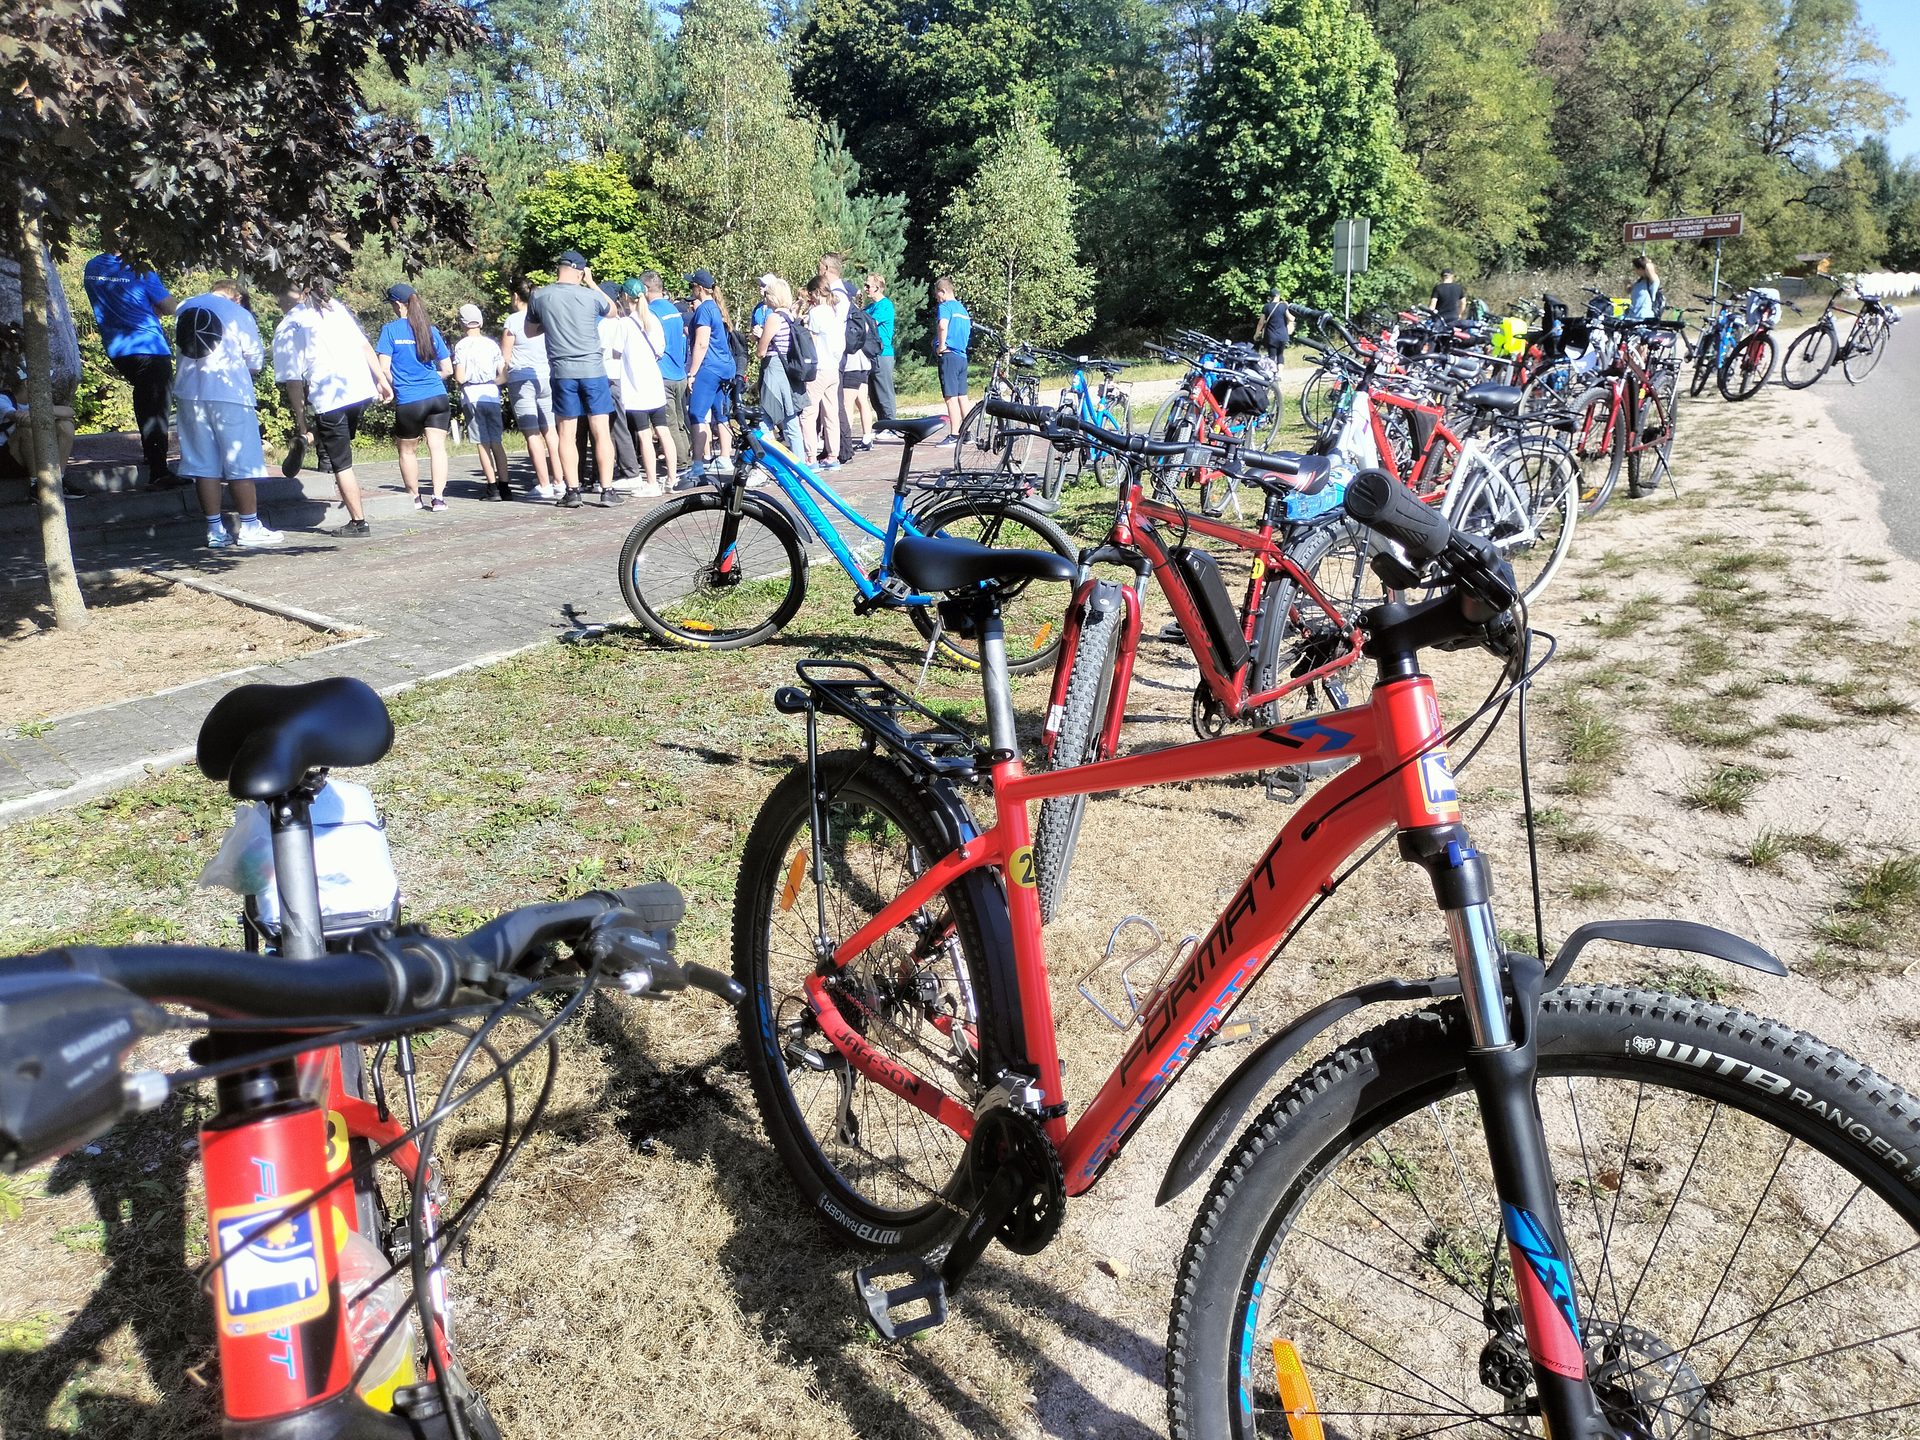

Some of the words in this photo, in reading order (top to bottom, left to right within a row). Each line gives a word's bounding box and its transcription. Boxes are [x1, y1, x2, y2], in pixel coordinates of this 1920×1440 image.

[1673, 230, 1705, 238] MONUMENT
[778, 471, 841, 551] FORMAT
[1119, 838, 1285, 1088] FORMAT
[834, 1028, 921, 1096] JAFFSON
[1655, 1038, 1791, 1096] WTB
[1789, 1087, 1909, 1169] RANGER
[823, 1200, 858, 1232] RANGER
[856, 1223, 897, 1244] WTB
